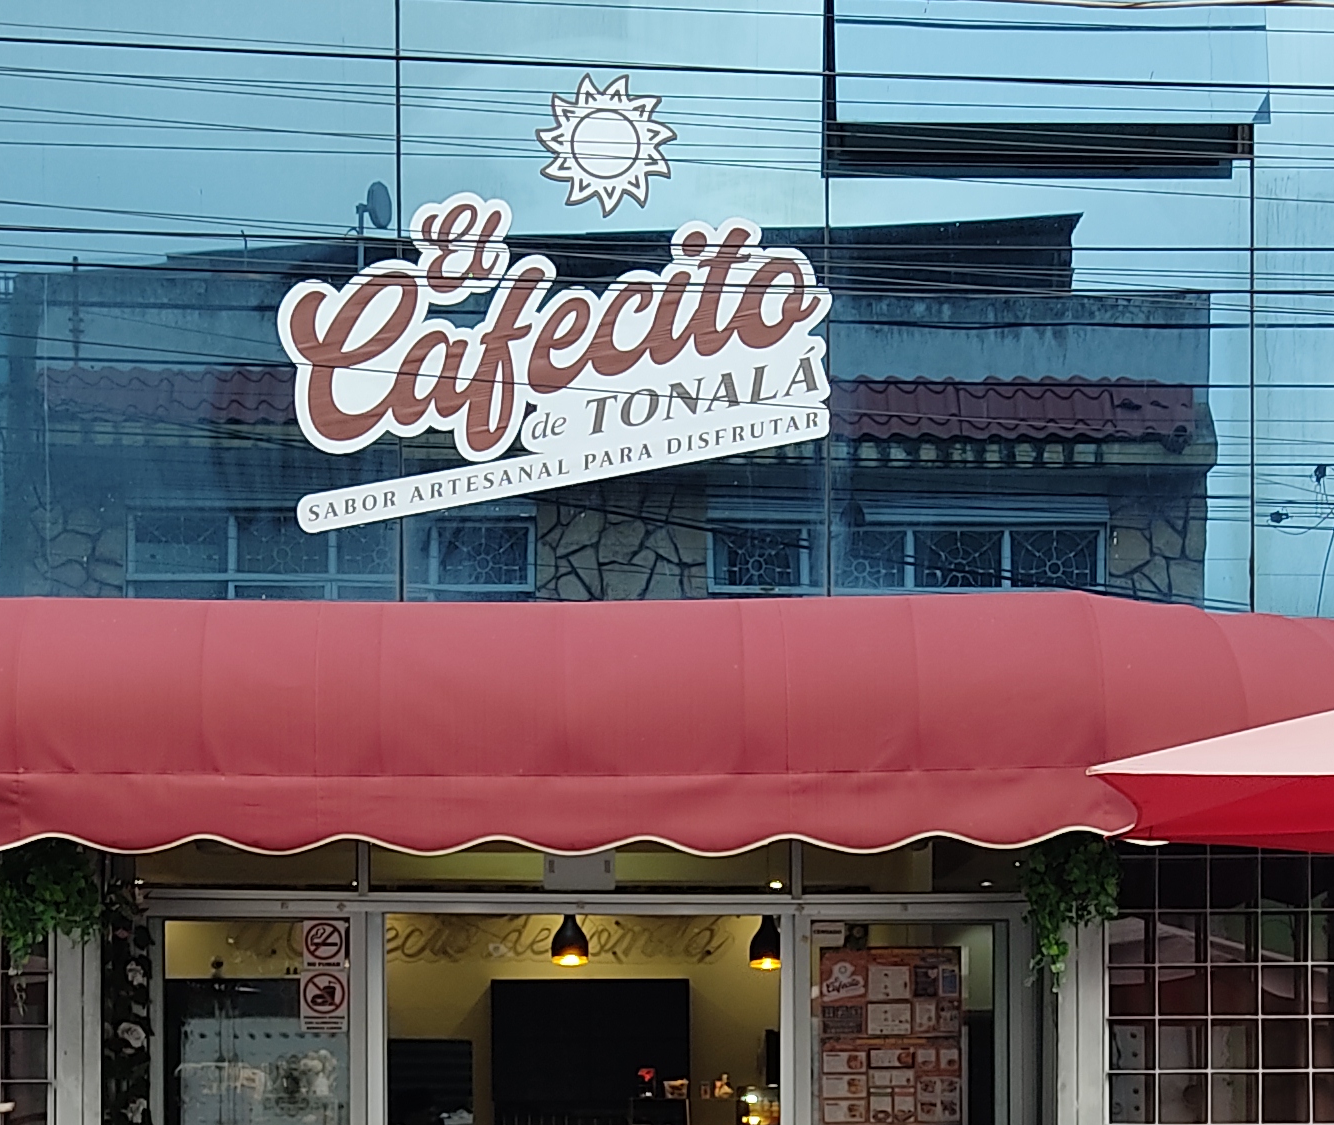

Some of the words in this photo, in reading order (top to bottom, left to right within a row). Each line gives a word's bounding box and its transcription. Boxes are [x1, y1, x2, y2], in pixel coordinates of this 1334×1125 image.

[422, 203, 505, 292] El
[290, 227, 821, 452] Cafecito
[531, 411, 567, 441] de
[586, 348, 820, 436] TONALÁ
[307, 490, 398, 523] SABOR
[409, 461, 570, 511] ARTESANAL
[583, 442, 653, 471] PARA
[666, 410, 820, 455] DISFRUTAR
